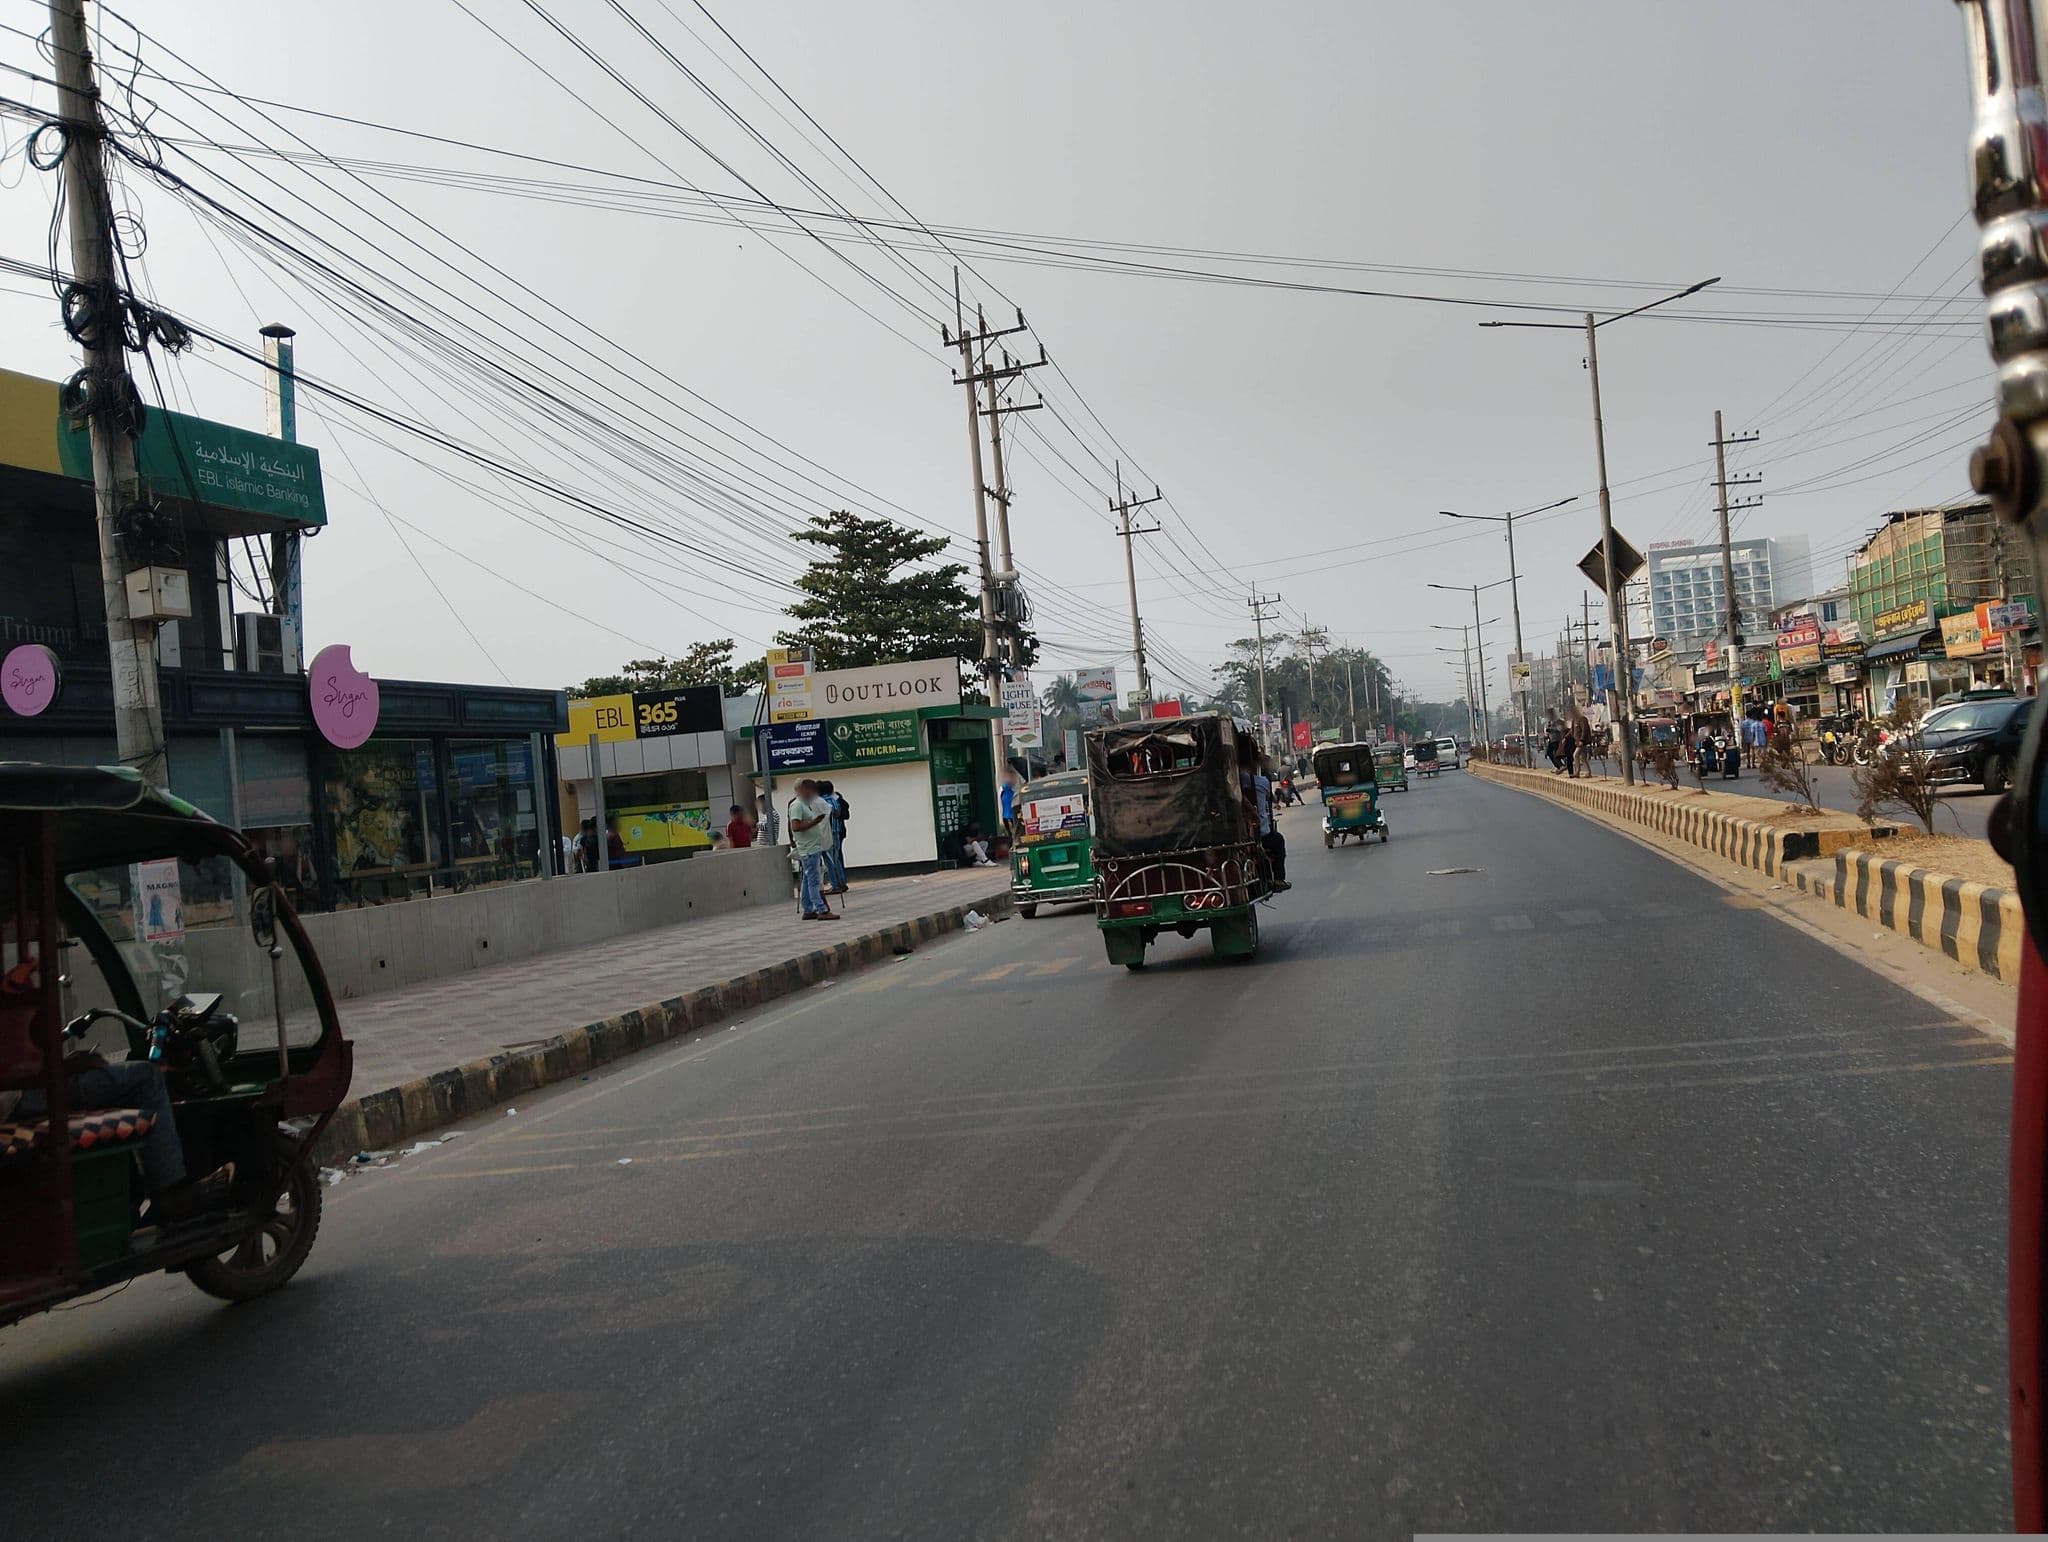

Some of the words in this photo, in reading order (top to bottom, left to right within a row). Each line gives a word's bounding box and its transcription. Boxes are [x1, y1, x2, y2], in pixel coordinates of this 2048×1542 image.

[195, 441, 255, 475] الإسلامية
[260, 457, 304, 482] البنكية
[198, 469, 223, 488] EBL
[266, 484, 309, 508] Banking
[842, 677, 943, 702] OUTLOOK
[1002, 689, 1031, 701] LIGHT
[595, 707, 630, 729] EBL
[638, 701, 678, 725] 365
[855, 745, 897, 757] ATM/CRM
